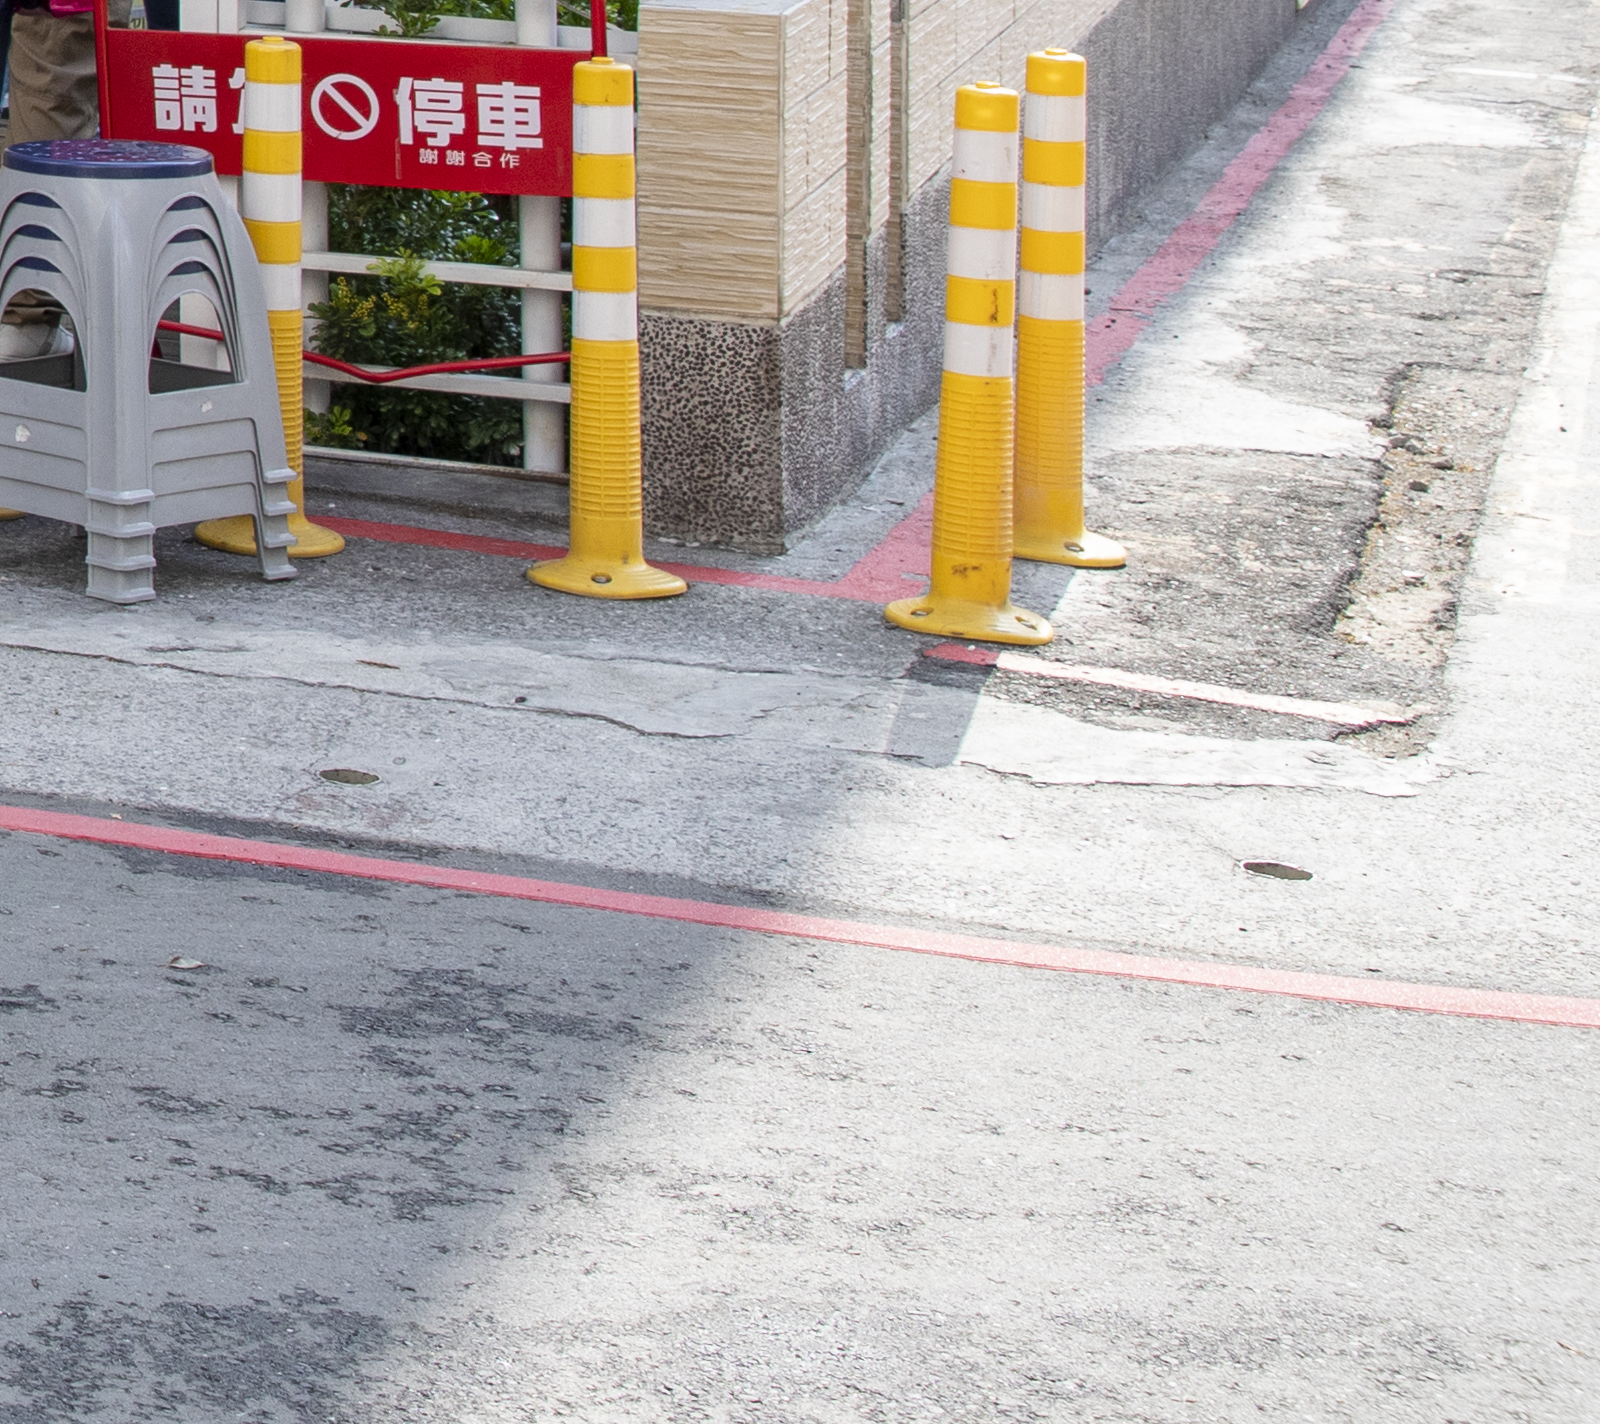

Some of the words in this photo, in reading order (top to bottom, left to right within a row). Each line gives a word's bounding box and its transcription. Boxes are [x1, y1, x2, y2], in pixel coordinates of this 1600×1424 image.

[152, 63, 246, 135] 請
[397, 76, 544, 151] 停車
[419, 148, 521, 169] 謝謝合作
